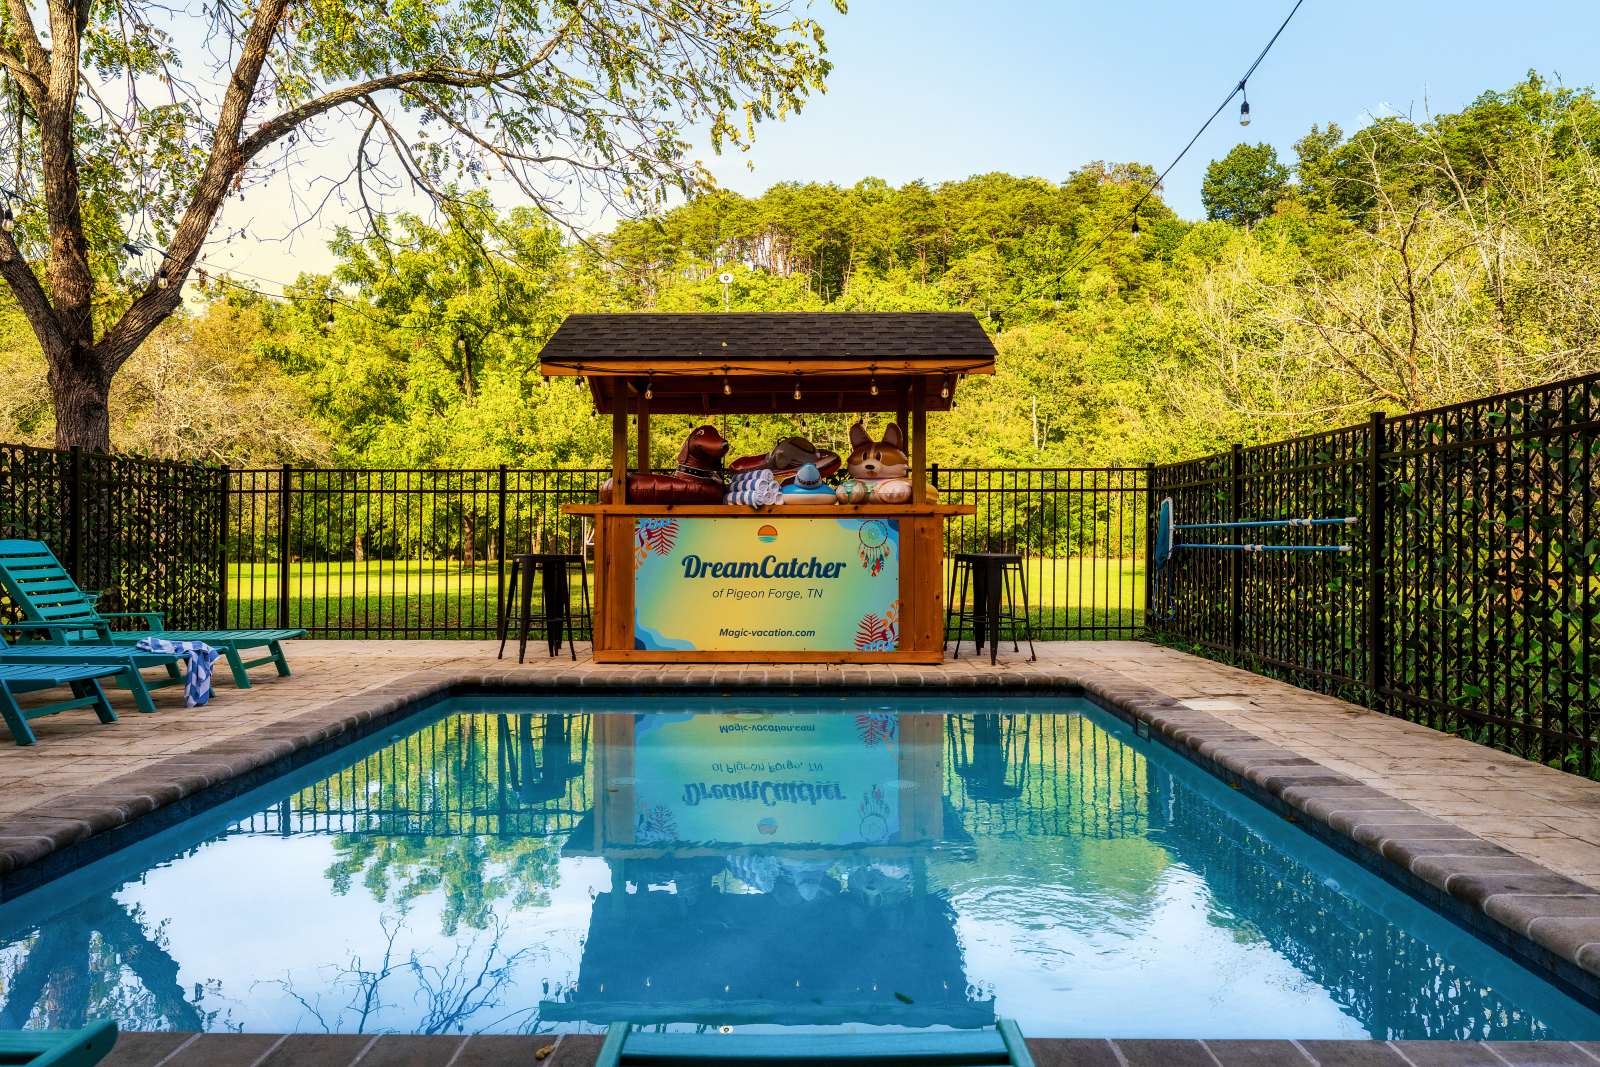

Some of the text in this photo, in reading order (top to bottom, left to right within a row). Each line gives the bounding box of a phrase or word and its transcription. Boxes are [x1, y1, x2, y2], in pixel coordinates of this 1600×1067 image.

[682, 554, 847, 579] DreamCatcher
[712, 588, 823, 600] of Pigeon Forge, TN
[719, 628, 816, 639] Magic-vacation.com
